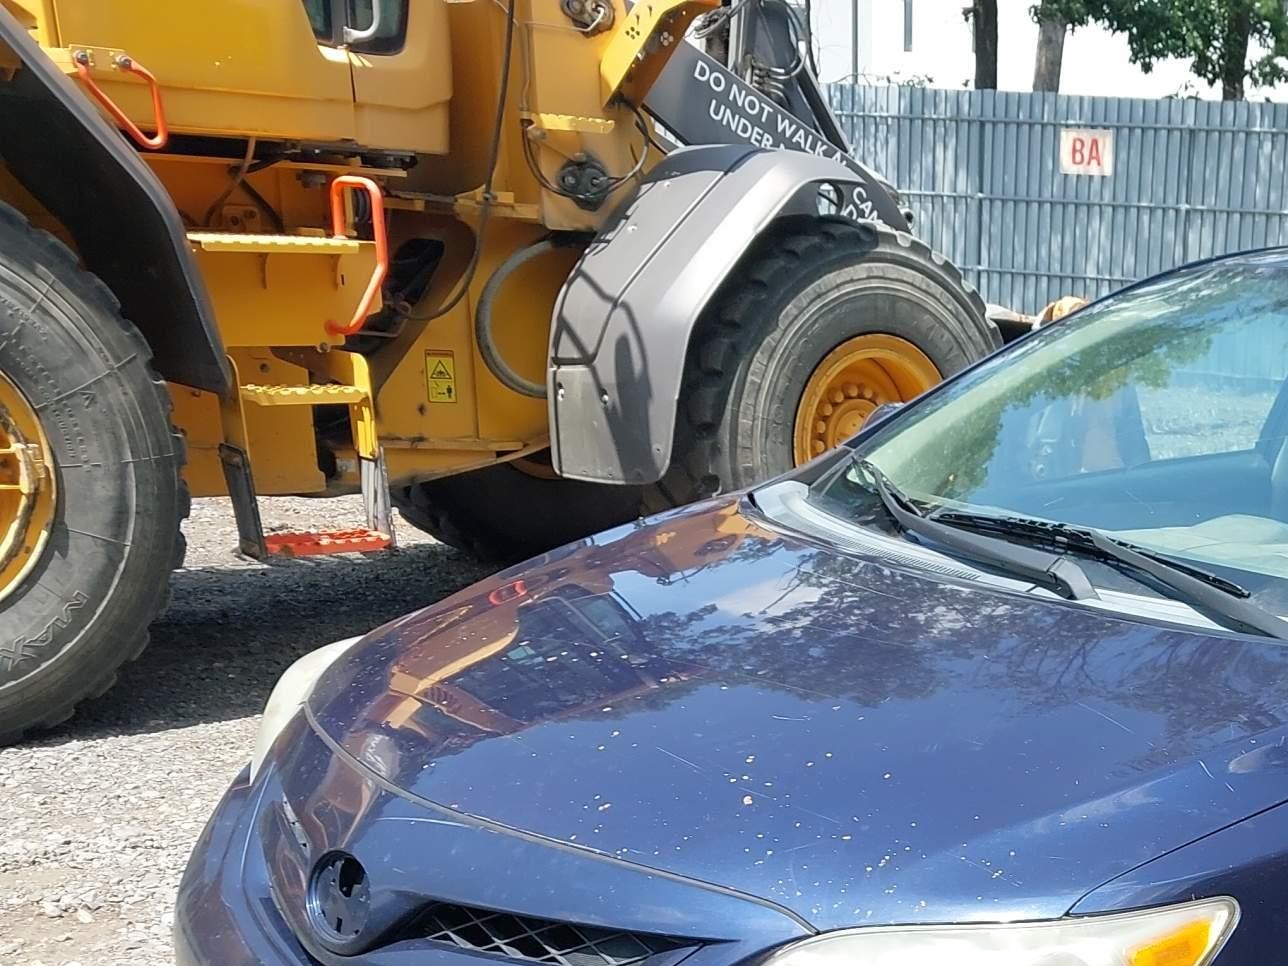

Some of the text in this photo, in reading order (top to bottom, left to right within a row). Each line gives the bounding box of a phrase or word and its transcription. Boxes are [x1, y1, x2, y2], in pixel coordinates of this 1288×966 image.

[694, 60, 726, 92] DO
[729, 84, 774, 122] NOT
[777, 114, 828, 157] WALK
[709, 99, 773, 149] UNDER
[1072, 138, 1101, 166] BA
